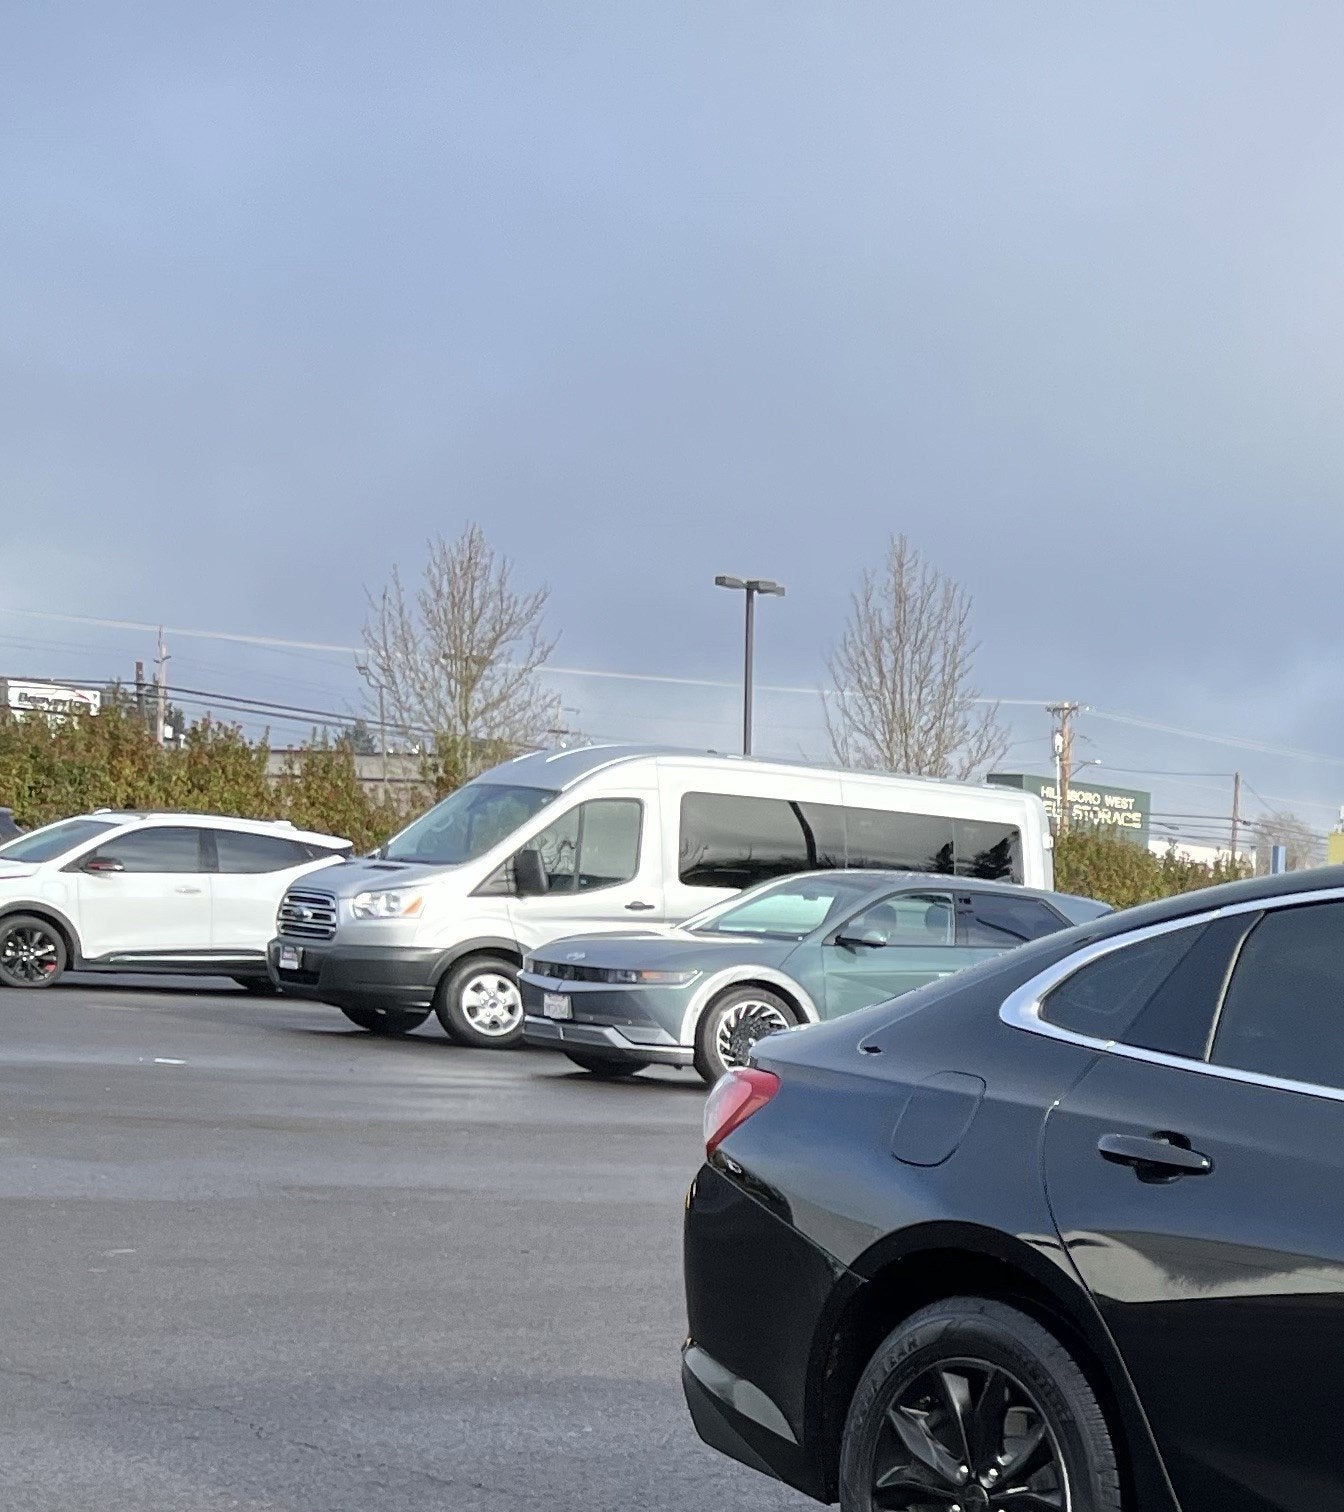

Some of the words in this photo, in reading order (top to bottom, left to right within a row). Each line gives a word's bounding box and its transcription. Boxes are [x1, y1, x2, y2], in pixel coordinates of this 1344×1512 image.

[1040, 785, 1101, 805] HILBORO
[1104, 794, 1135, 810] WEST
[1072, 805, 1141, 828] STORAGE
